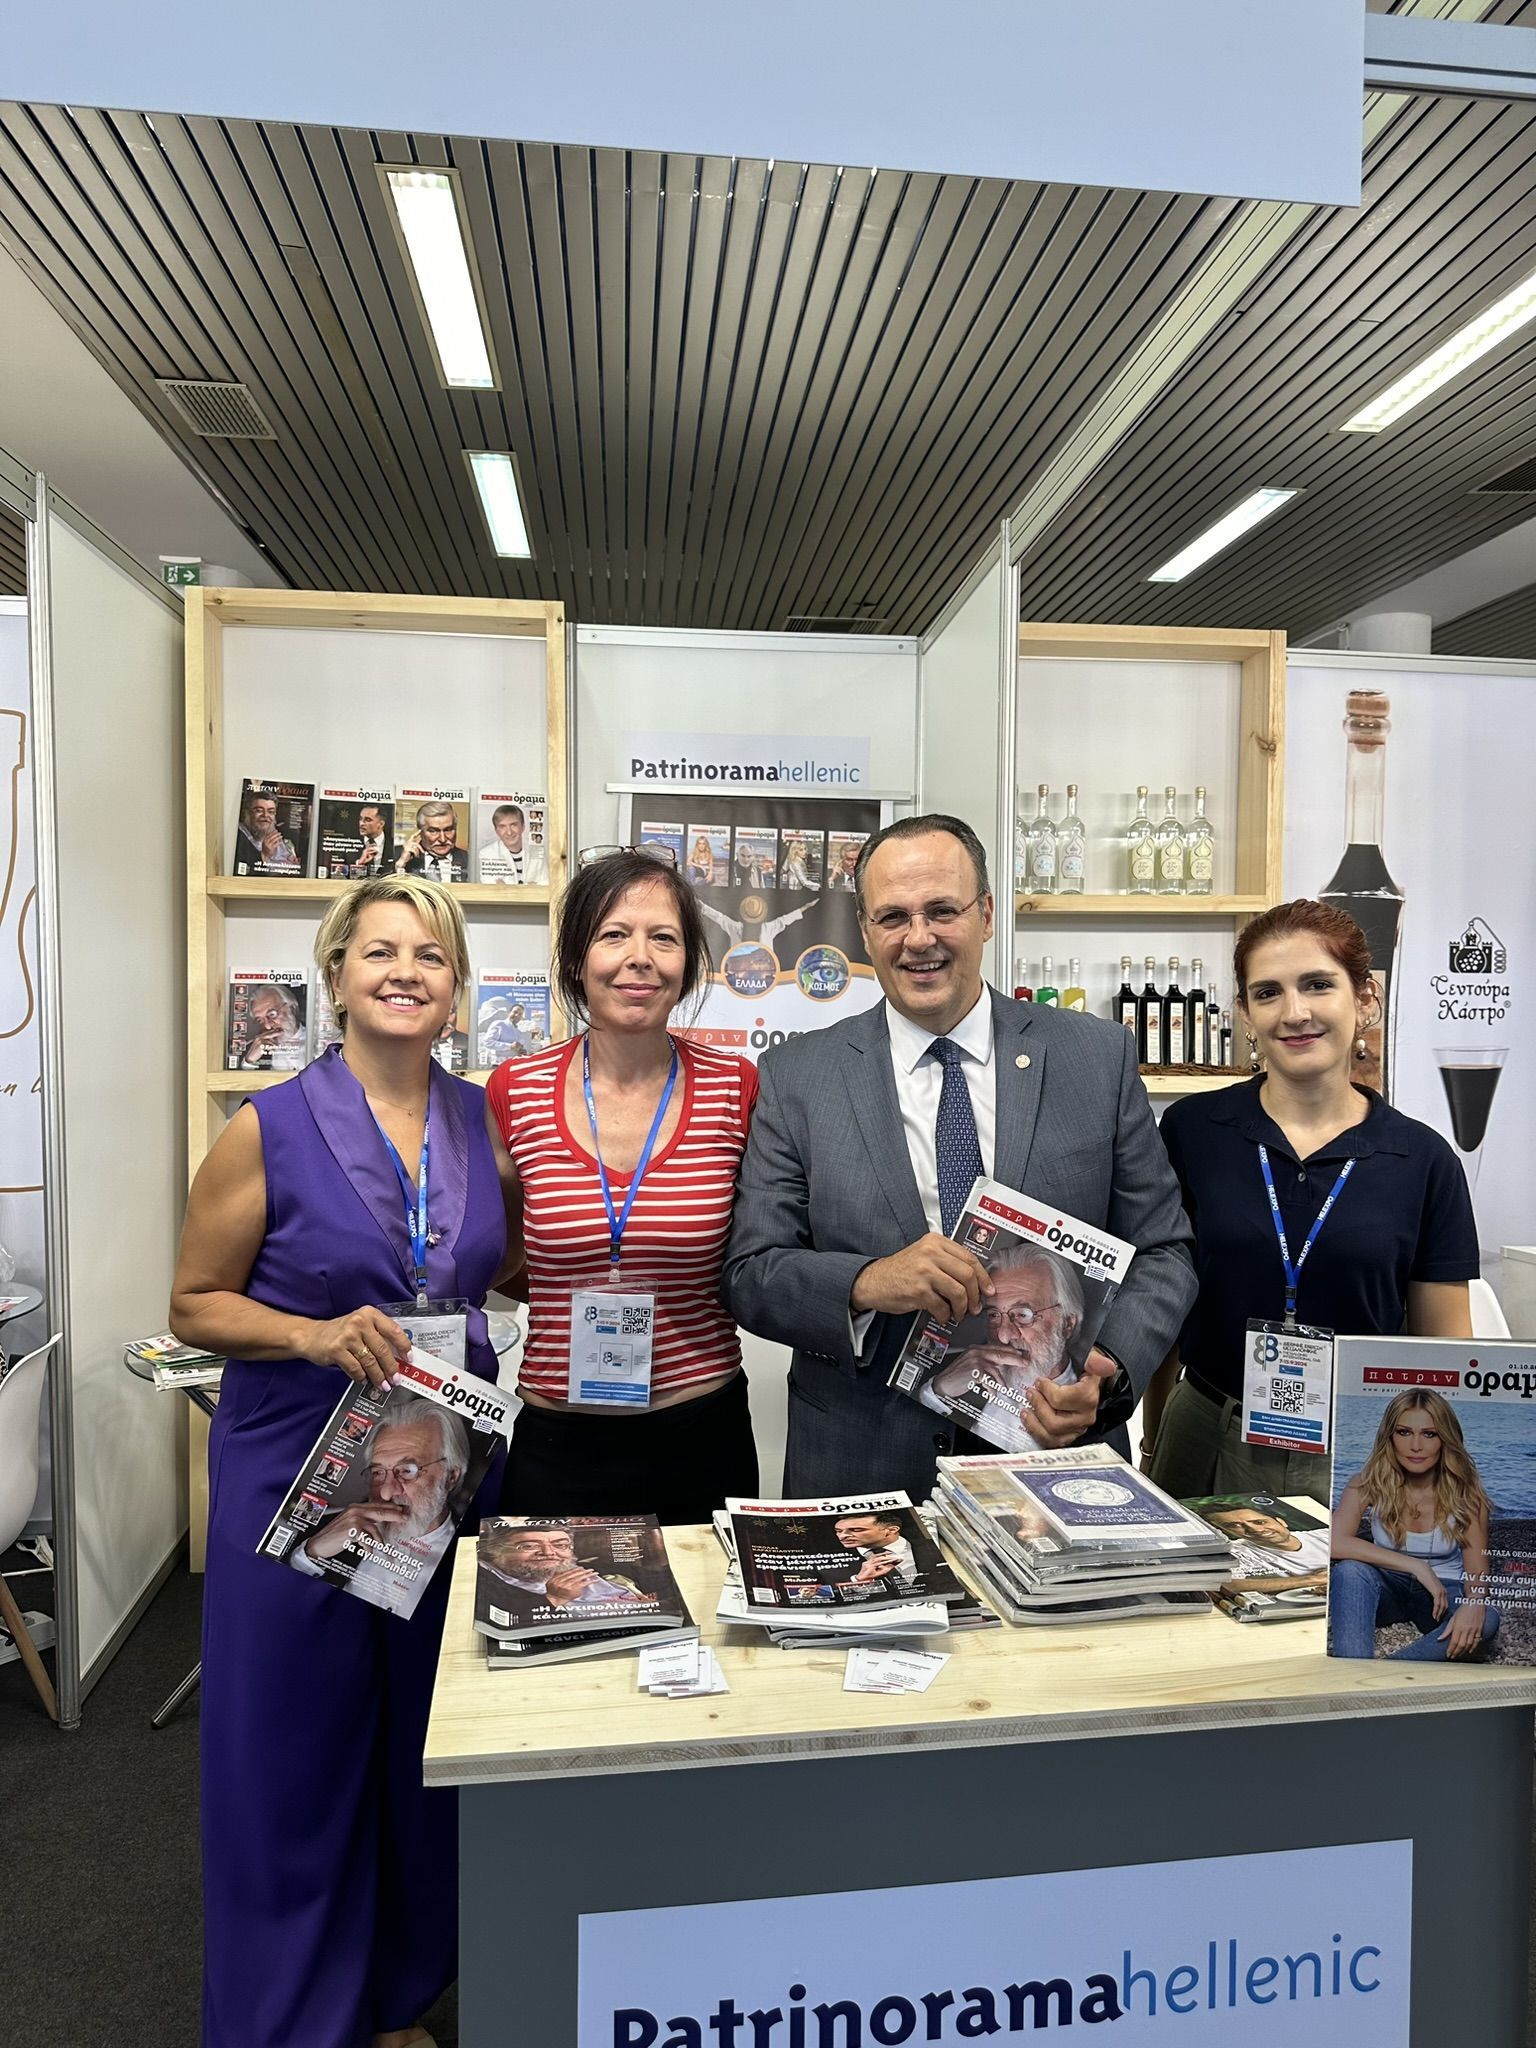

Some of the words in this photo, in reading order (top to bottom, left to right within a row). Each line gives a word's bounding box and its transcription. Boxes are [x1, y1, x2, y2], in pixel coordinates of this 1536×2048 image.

[631, 758, 860, 783] Patrinoramahellenic
[358, 788, 391, 801] όραμα
[433, 787, 464, 800] όραμα
[514, 792, 546, 805] όραμα
[269, 969, 303, 982] όραμα
[515, 972, 547, 985] όραμα
[735, 978, 767, 989] ΕΛΛΑΔΑ
[809, 981, 840, 992] ΚΟΣΜΟΣ
[1430, 975, 1510, 1003] Τεντούρα
[1438, 999, 1505, 1025] Κάστρο
[1267, 1184, 1280, 1211] HELEXPO
[1317, 1195, 1335, 1222] HELEXPO
[1047, 1218, 1117, 1272] όραμα
[1279, 1232, 1290, 1261] HELEXPO
[1296, 1240, 1312, 1267] HELEXPO
[1369, 1371, 1453, 1383] πατριν
[966, 1381, 981, 1395] θα
[441, 1374, 506, 1424] όραμα
[1269, 1437, 1301, 1449] Exhibitor
[821, 1500, 900, 1513] όραμα
[348, 1527, 359, 1539] Ο
[357, 1532, 424, 1571] Καποδίστριας
[1481, 1549, 1511, 1557] ΝΑΤΑΣΑ
[342, 1540, 358, 1555] θα
[356, 1545, 419, 1583] αγιοποιηθεί!
[756, 1563, 814, 1571] εμφάνισή
[1461, 1571, 1476, 1581] Αν
[1480, 1572, 1514, 1584] έχουν
[532, 1605, 551, 1613] «Η
[555, 1601, 660, 1612] Αντιπολίτευση
[532, 1611, 573, 1620] κάνει
